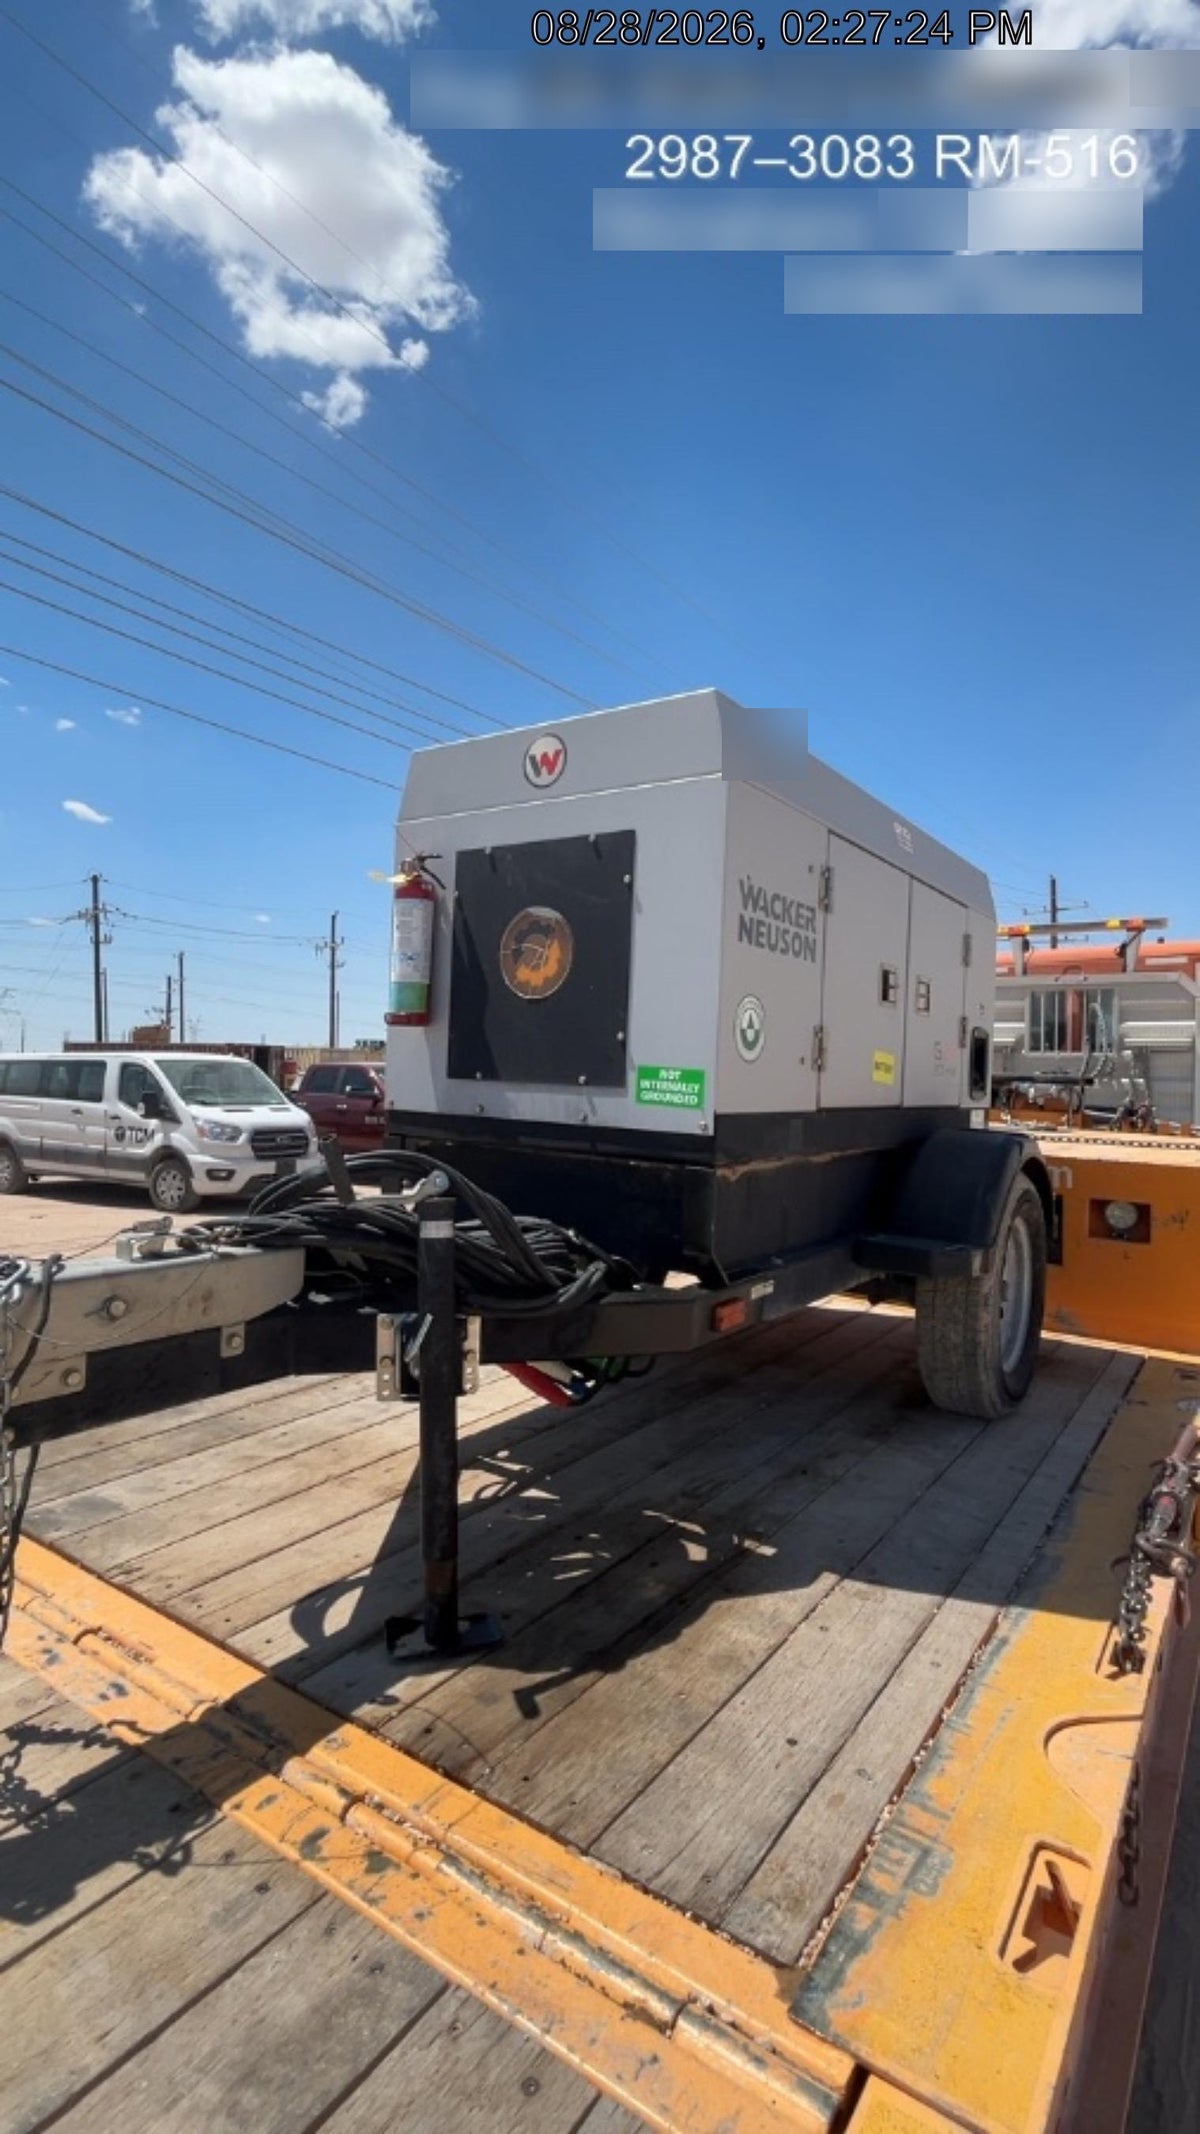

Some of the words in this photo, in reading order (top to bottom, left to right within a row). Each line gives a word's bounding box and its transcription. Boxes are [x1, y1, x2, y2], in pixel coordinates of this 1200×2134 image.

[528, 749, 562, 778] W
[739, 874, 816, 934] WACKER
[737, 913, 816, 963] NEUSON
[659, 1069, 682, 1080] NOT
[127, 1125, 155, 1144] TCM
